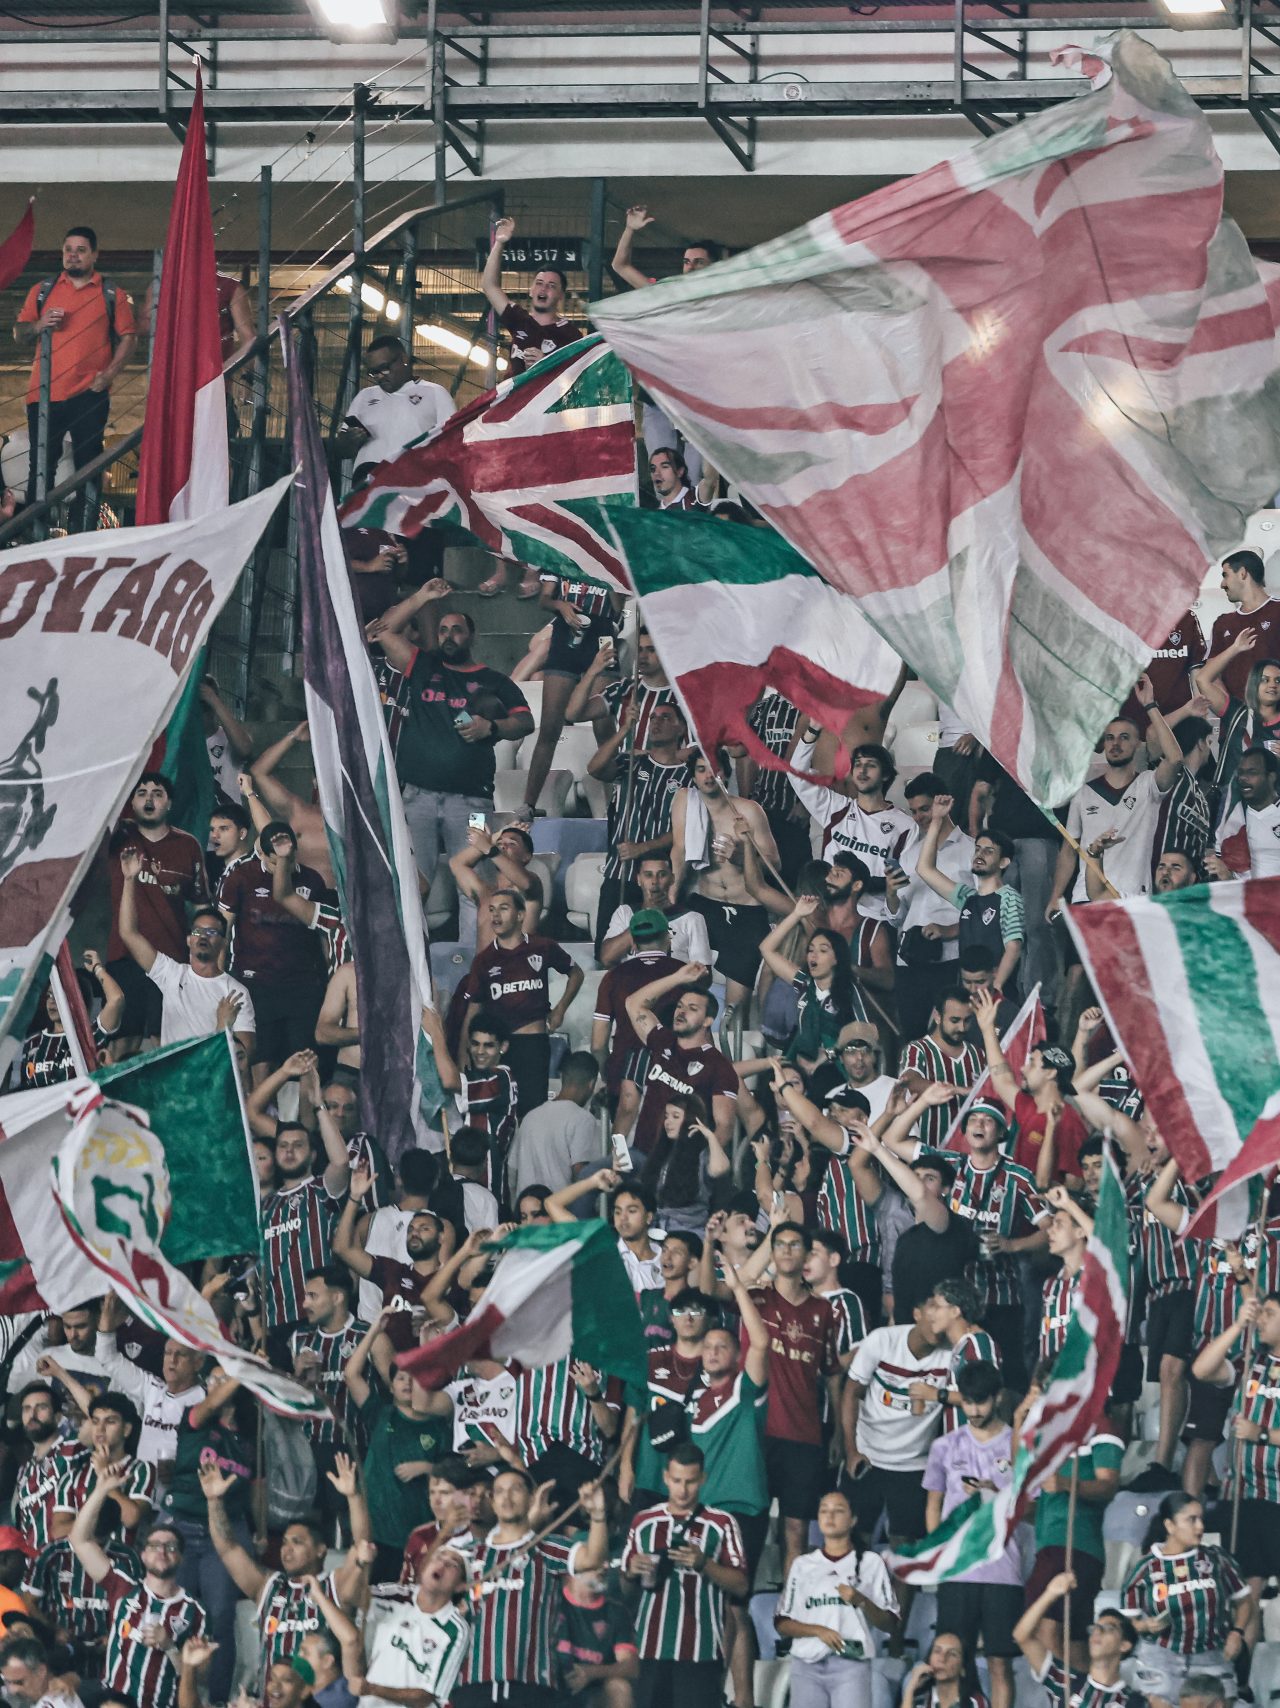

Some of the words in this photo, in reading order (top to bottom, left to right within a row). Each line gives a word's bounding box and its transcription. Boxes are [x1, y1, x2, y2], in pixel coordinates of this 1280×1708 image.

[534, 250, 559, 262] 517
[569, 583, 607, 598] BETANO
[1152, 645, 1188, 659] med
[832, 831, 891, 860] unimed
[502, 979, 543, 996] BETANO
[659, 1071, 694, 1095] BETANO
[265, 1217, 302, 1241] BETANO
[1168, 1577, 1217, 1596] BETANO
